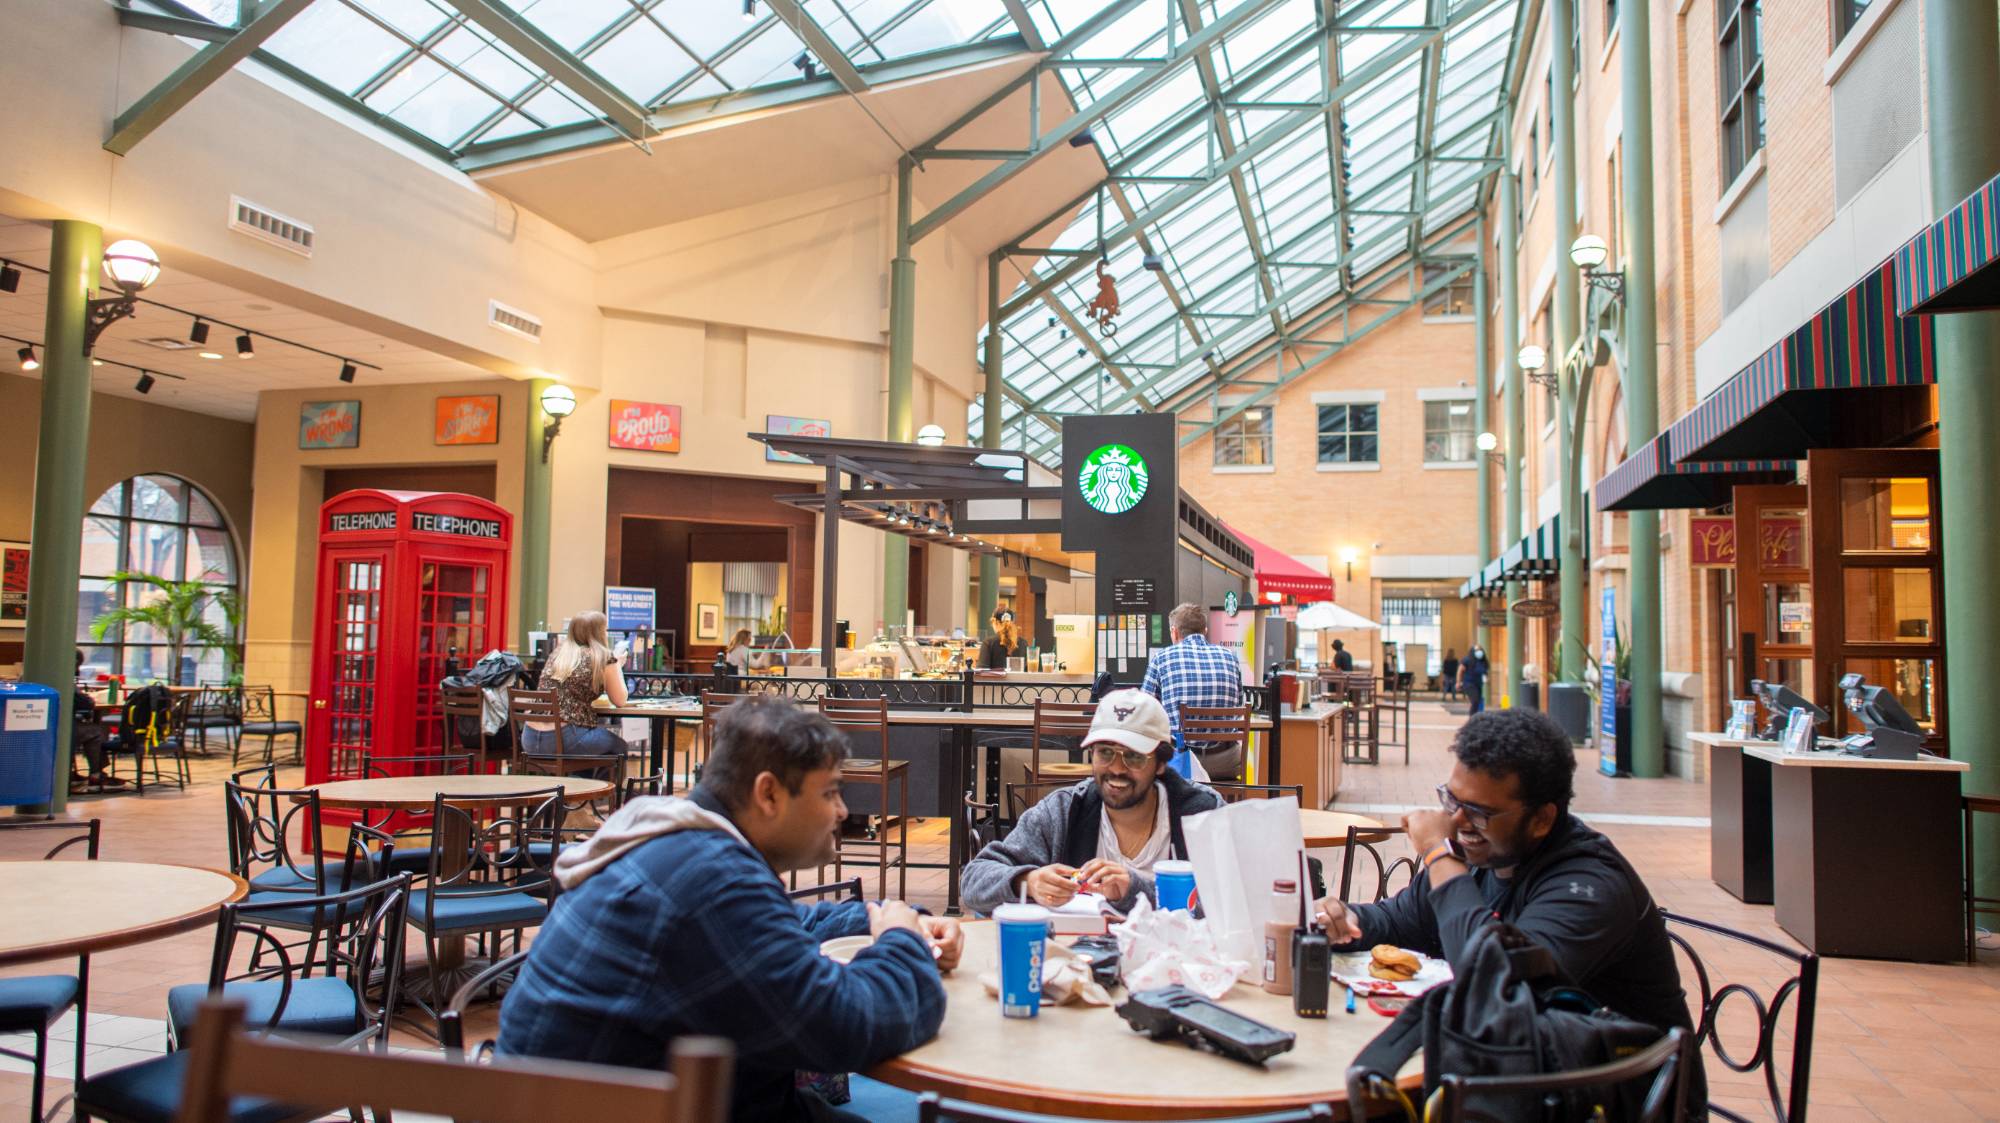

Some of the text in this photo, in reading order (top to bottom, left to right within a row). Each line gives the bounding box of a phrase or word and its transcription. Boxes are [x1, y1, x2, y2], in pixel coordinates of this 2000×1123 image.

[306, 414, 353, 443] WRONG
[443, 407, 492, 440] SORRY
[617, 410, 670, 443] PROUD
[648, 433, 672, 447] YOU
[332, 512, 397, 530] TELEPHONE
[414, 513, 499, 538] TELEPHONE
[1696, 524, 1735, 562] Pla
[608, 593, 653, 601] FEELING UNDER
[1027, 939, 1042, 993] pepsi
